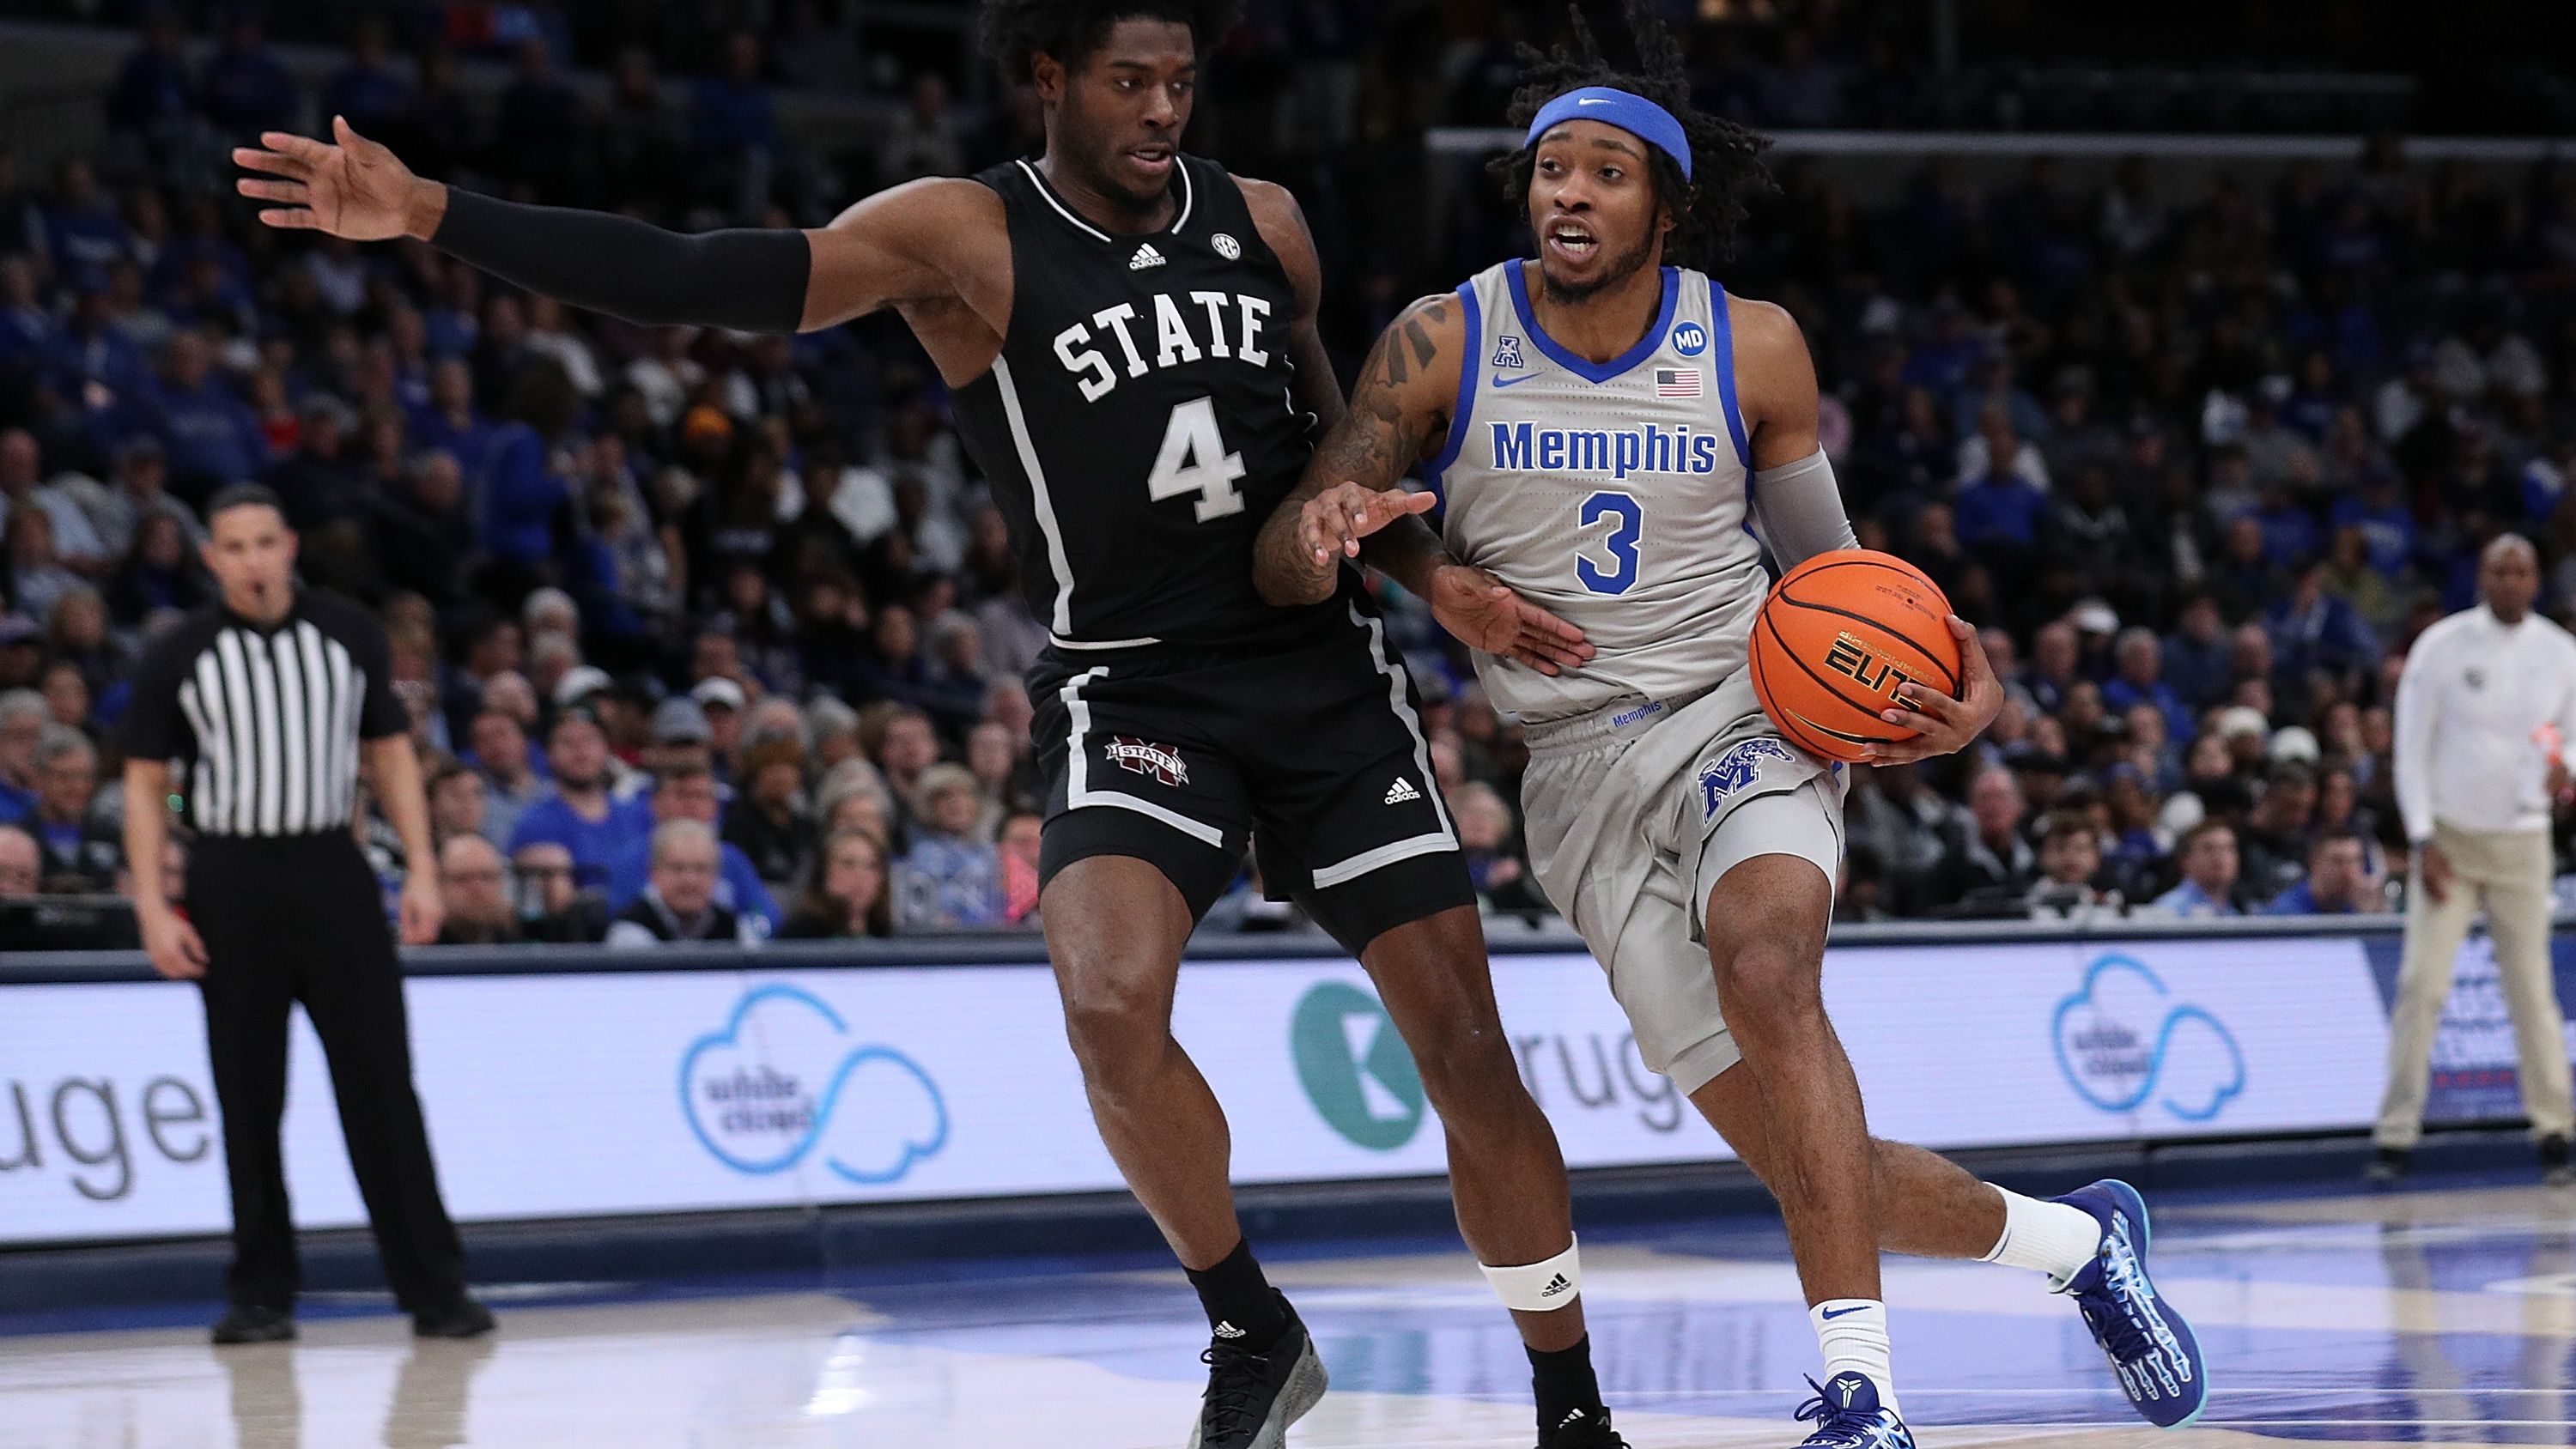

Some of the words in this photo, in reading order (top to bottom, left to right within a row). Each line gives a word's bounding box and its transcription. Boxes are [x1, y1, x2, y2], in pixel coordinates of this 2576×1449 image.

[1129, 256, 1166, 270] adidas
[1053, 291, 1271, 403] STATE
[1674, 329, 1704, 349] MD
[1147, 396, 1247, 524] 4
[1485, 420, 1717, 480] Memphis
[1575, 491, 1643, 596] 3
[1613, 700, 1662, 728] Memphis
[1123, 746, 1174, 769] STATE
[1385, 791, 1421, 805] adidas
[1542, 1282, 1571, 1297] adidas
